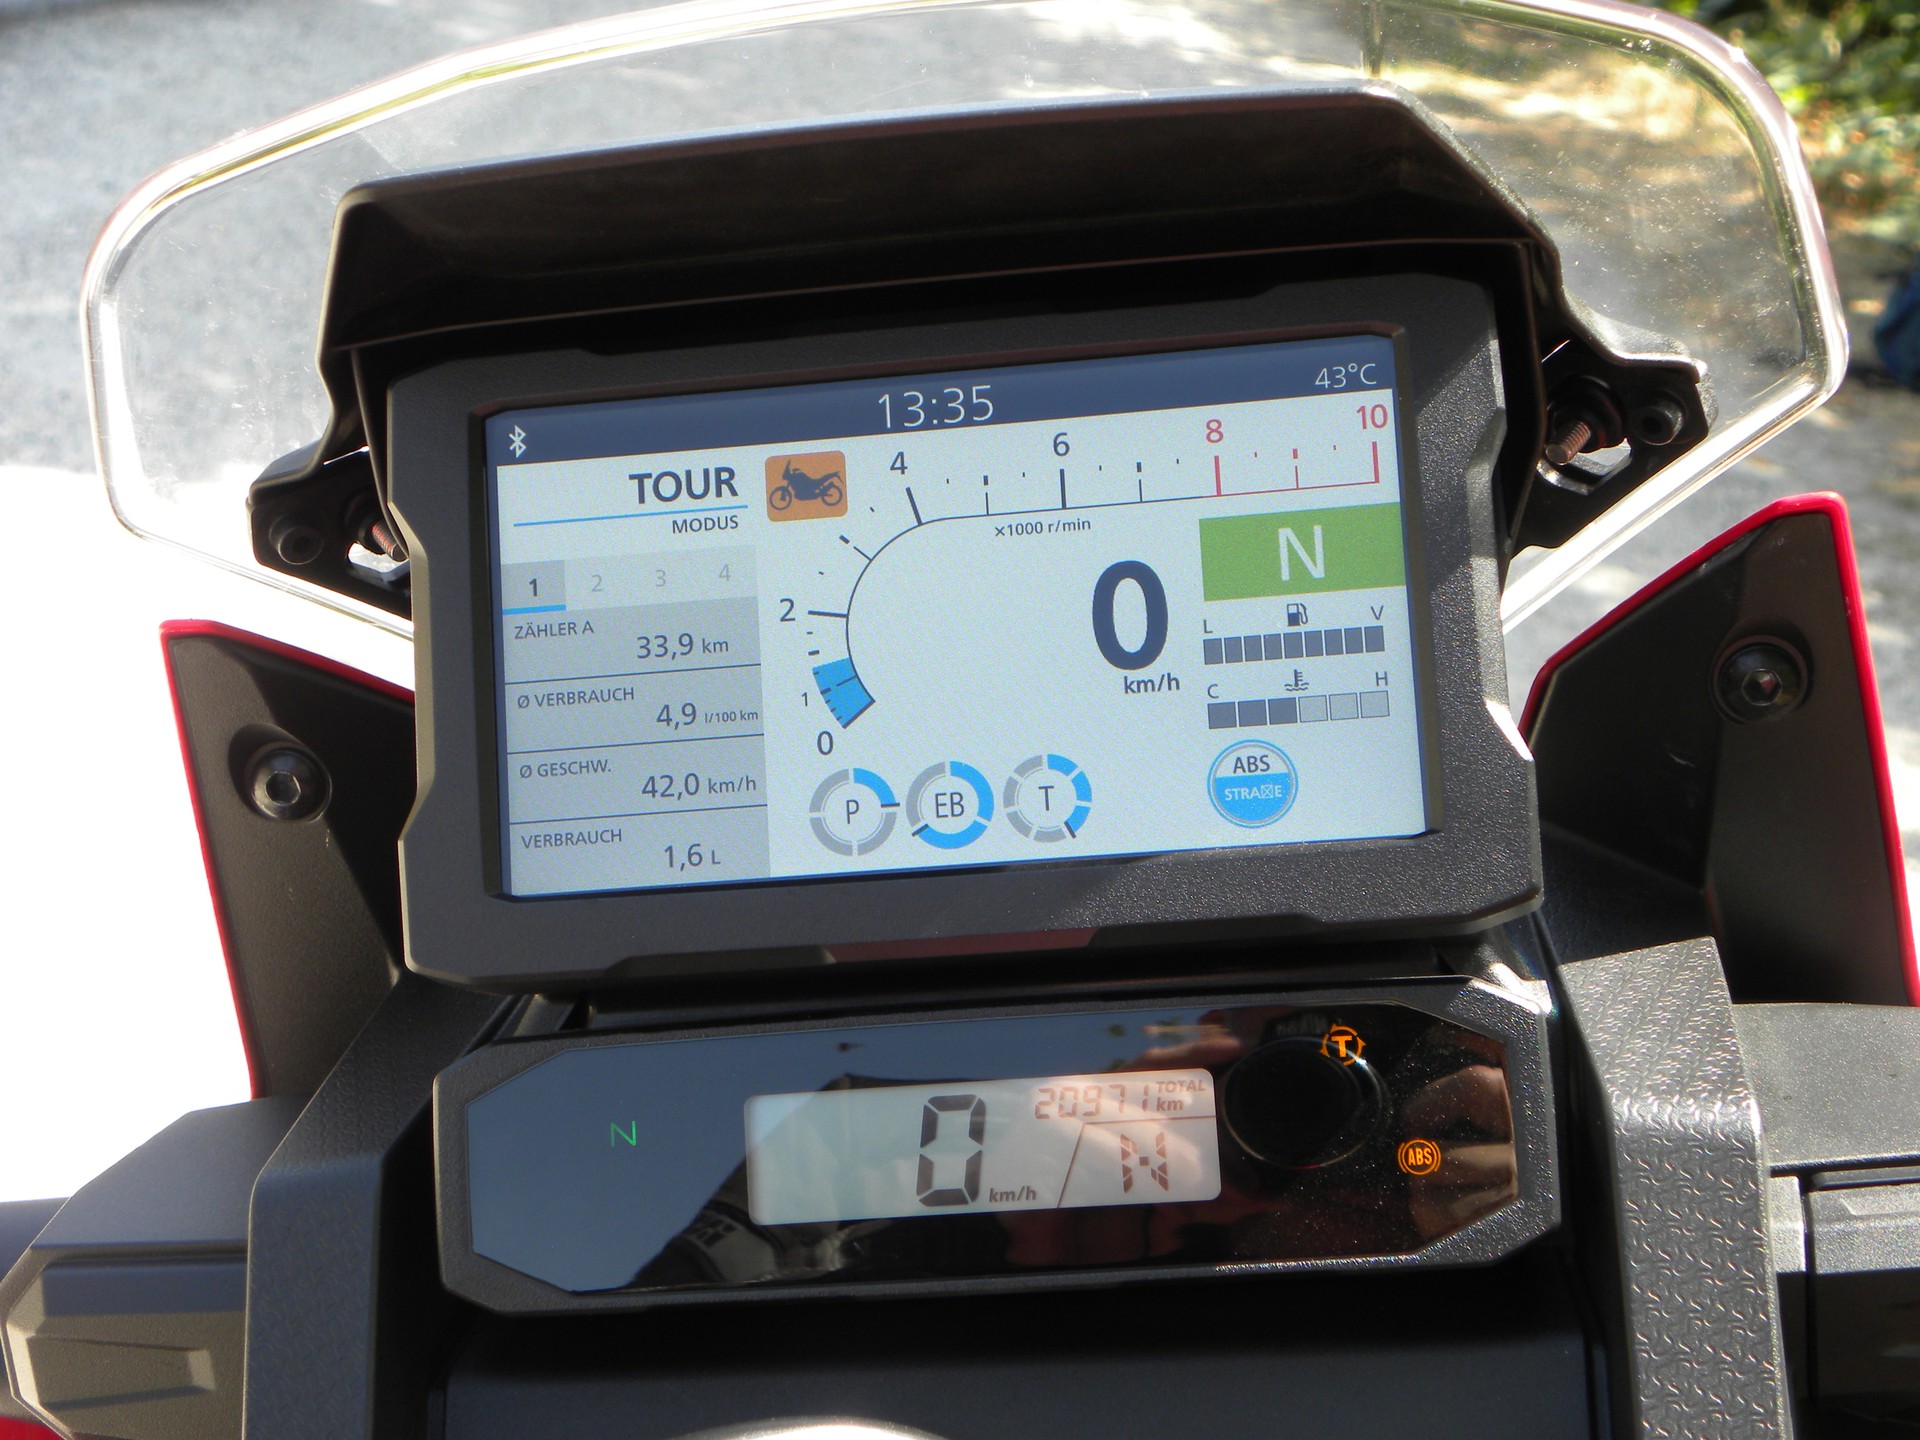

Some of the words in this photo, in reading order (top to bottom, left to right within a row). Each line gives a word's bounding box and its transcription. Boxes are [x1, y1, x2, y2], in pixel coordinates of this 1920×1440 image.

[1315, 363, 1377, 389] 43°C
[878, 385, 994, 428] 13:35
[1356, 403, 1388, 430] 10
[1206, 418, 1224, 443] 8
[1053, 432, 1070, 456] 6
[890, 451, 907, 475] 4
[629, 466, 739, 504] TOUR
[671, 515, 739, 534] MODUS
[1048, 518, 1091, 533] r/min
[1278, 525, 1325, 581] N
[591, 575, 603, 592] 2
[656, 569, 667, 587] 3
[719, 564, 732, 582] 4
[529, 578, 538, 597] 1
[779, 598, 795, 622] 2
[1092, 560, 1168, 670] 0
[1370, 605, 1384, 620] V
[514, 621, 578, 640] ZÄHLER
[582, 621, 594, 635] A
[1203, 619, 1213, 634] L
[637, 632, 694, 660] 33,9
[702, 638, 729, 654] km
[1124, 673, 1180, 694] km/h
[1375, 671, 1388, 686] H
[535, 687, 634, 707] VERBRAUCH
[801, 692, 809, 707] 1
[1207, 684, 1219, 699] C
[656, 703, 696, 730] 4,9
[740, 710, 758, 721] km
[817, 730, 834, 755] 0
[537, 759, 611, 777] GESCHW.
[1232, 754, 1271, 774] ABS
[641, 773, 700, 800] 42,0
[708, 776, 756, 794] km/h
[1038, 785, 1054, 811] T
[845, 799, 860, 824] P
[934, 791, 965, 818] EB
[521, 829, 622, 849] VERBRAUCH
[664, 843, 703, 871] 1,6
[711, 850, 721, 864] L
[1331, 1035, 1352, 1058] T
[1156, 1079, 1206, 1094] TOTAL
[1035, 1083, 1148, 1120] 20971
[1156, 1098, 1183, 1112] km
[610, 1120, 637, 1148] N
[916, 1094, 986, 1207] 0
[989, 1186, 1036, 1203] km/h
[1408, 1148, 1433, 1165] ABS
